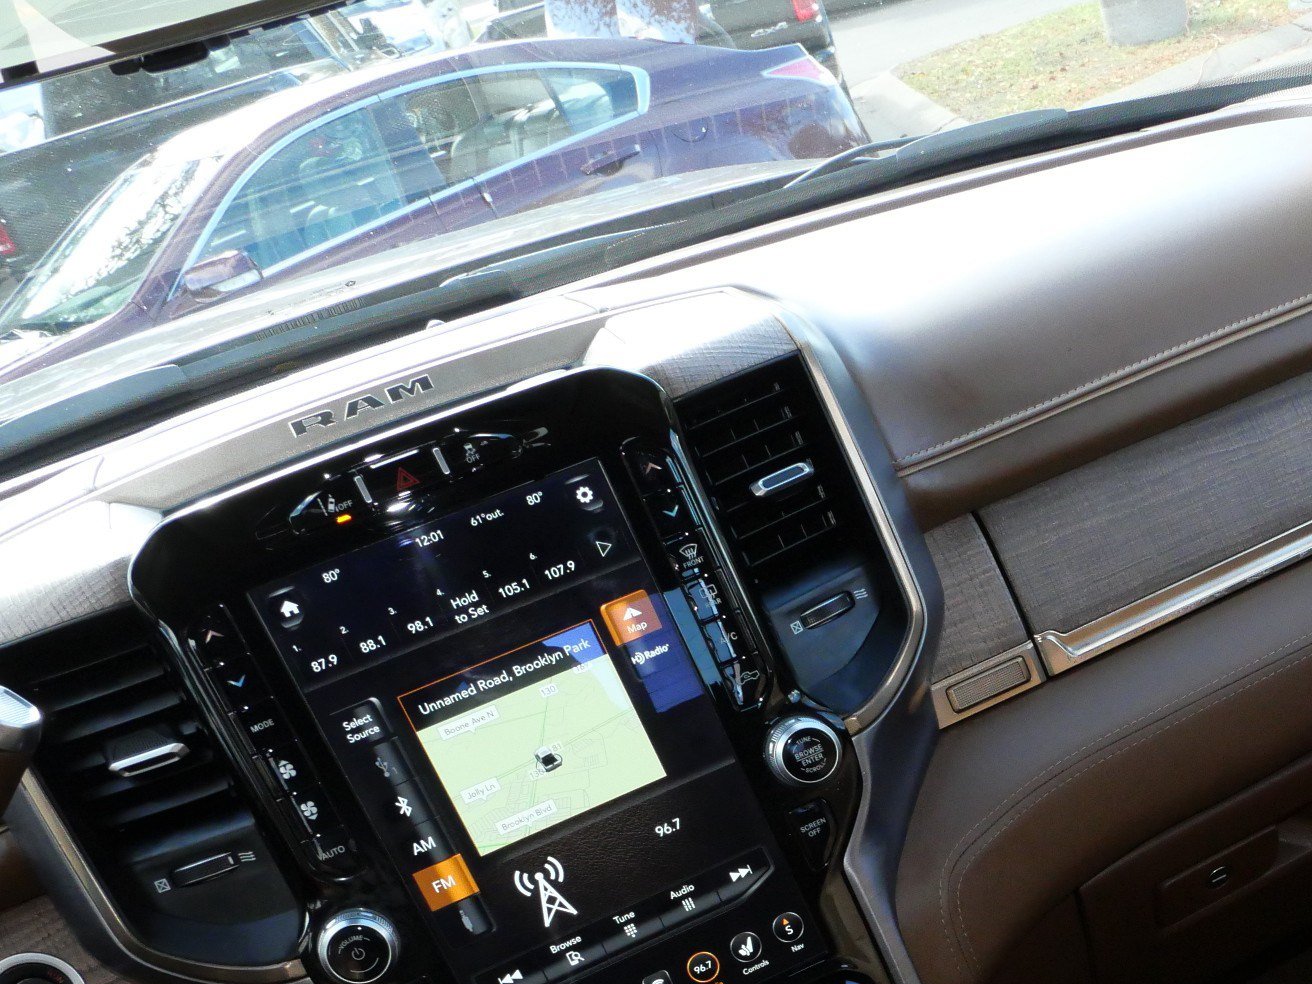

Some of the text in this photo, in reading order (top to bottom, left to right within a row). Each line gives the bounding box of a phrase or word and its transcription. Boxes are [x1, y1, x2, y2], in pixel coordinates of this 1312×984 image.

[288, 373, 435, 438] RAM
[466, 452, 481, 464] OFF
[338, 500, 353, 512] OFF
[526, 491, 543, 506] 80°
[415, 529, 445, 548] 12:01
[544, 560, 576, 581] 107.9
[683, 555, 705, 569] FRONT
[322, 568, 341, 585] 80°
[498, 578, 531, 600] 105.1
[450, 590, 479, 610] Hold
[704, 597, 722, 610] RR
[454, 604, 490, 625] to Set
[338, 625, 349, 635] 2.
[407, 616, 435, 635] 98.1
[627, 622, 648, 634] Map
[360, 635, 387, 654] 88.1
[310, 654, 338, 673] 87.9
[418, 638, 592, 715] Unnamed Road, Brooklyn Park
[540, 684, 556, 697] 130
[250, 718, 275, 734] MODE
[342, 714, 373, 732] Select
[444, 710, 495, 736] Boone Ave N
[346, 726, 380, 744] Source
[794, 744, 823, 760] BROWSE
[802, 753, 824, 767] ENTER
[467, 783, 496, 800] Jolly Ln
[501, 804, 552, 831] Brooklyn Blvd
[800, 817, 826, 834] SCREEN
[654, 818, 681, 838] 96.7
[808, 827, 822, 838] OFF
[322, 845, 346, 861] AUTO
[412, 836, 436, 856] AM
[432, 874, 456, 894] FM
[670, 884, 695, 900] Audio
[612, 910, 636, 926] Tune
[785, 925, 794, 936] S
[339, 934, 364, 950] VOLUME
[550, 936, 582, 954] Browse
[791, 943, 805, 952] Nav
[694, 960, 712, 974] 96.7
[742, 960, 770, 976] Controls
